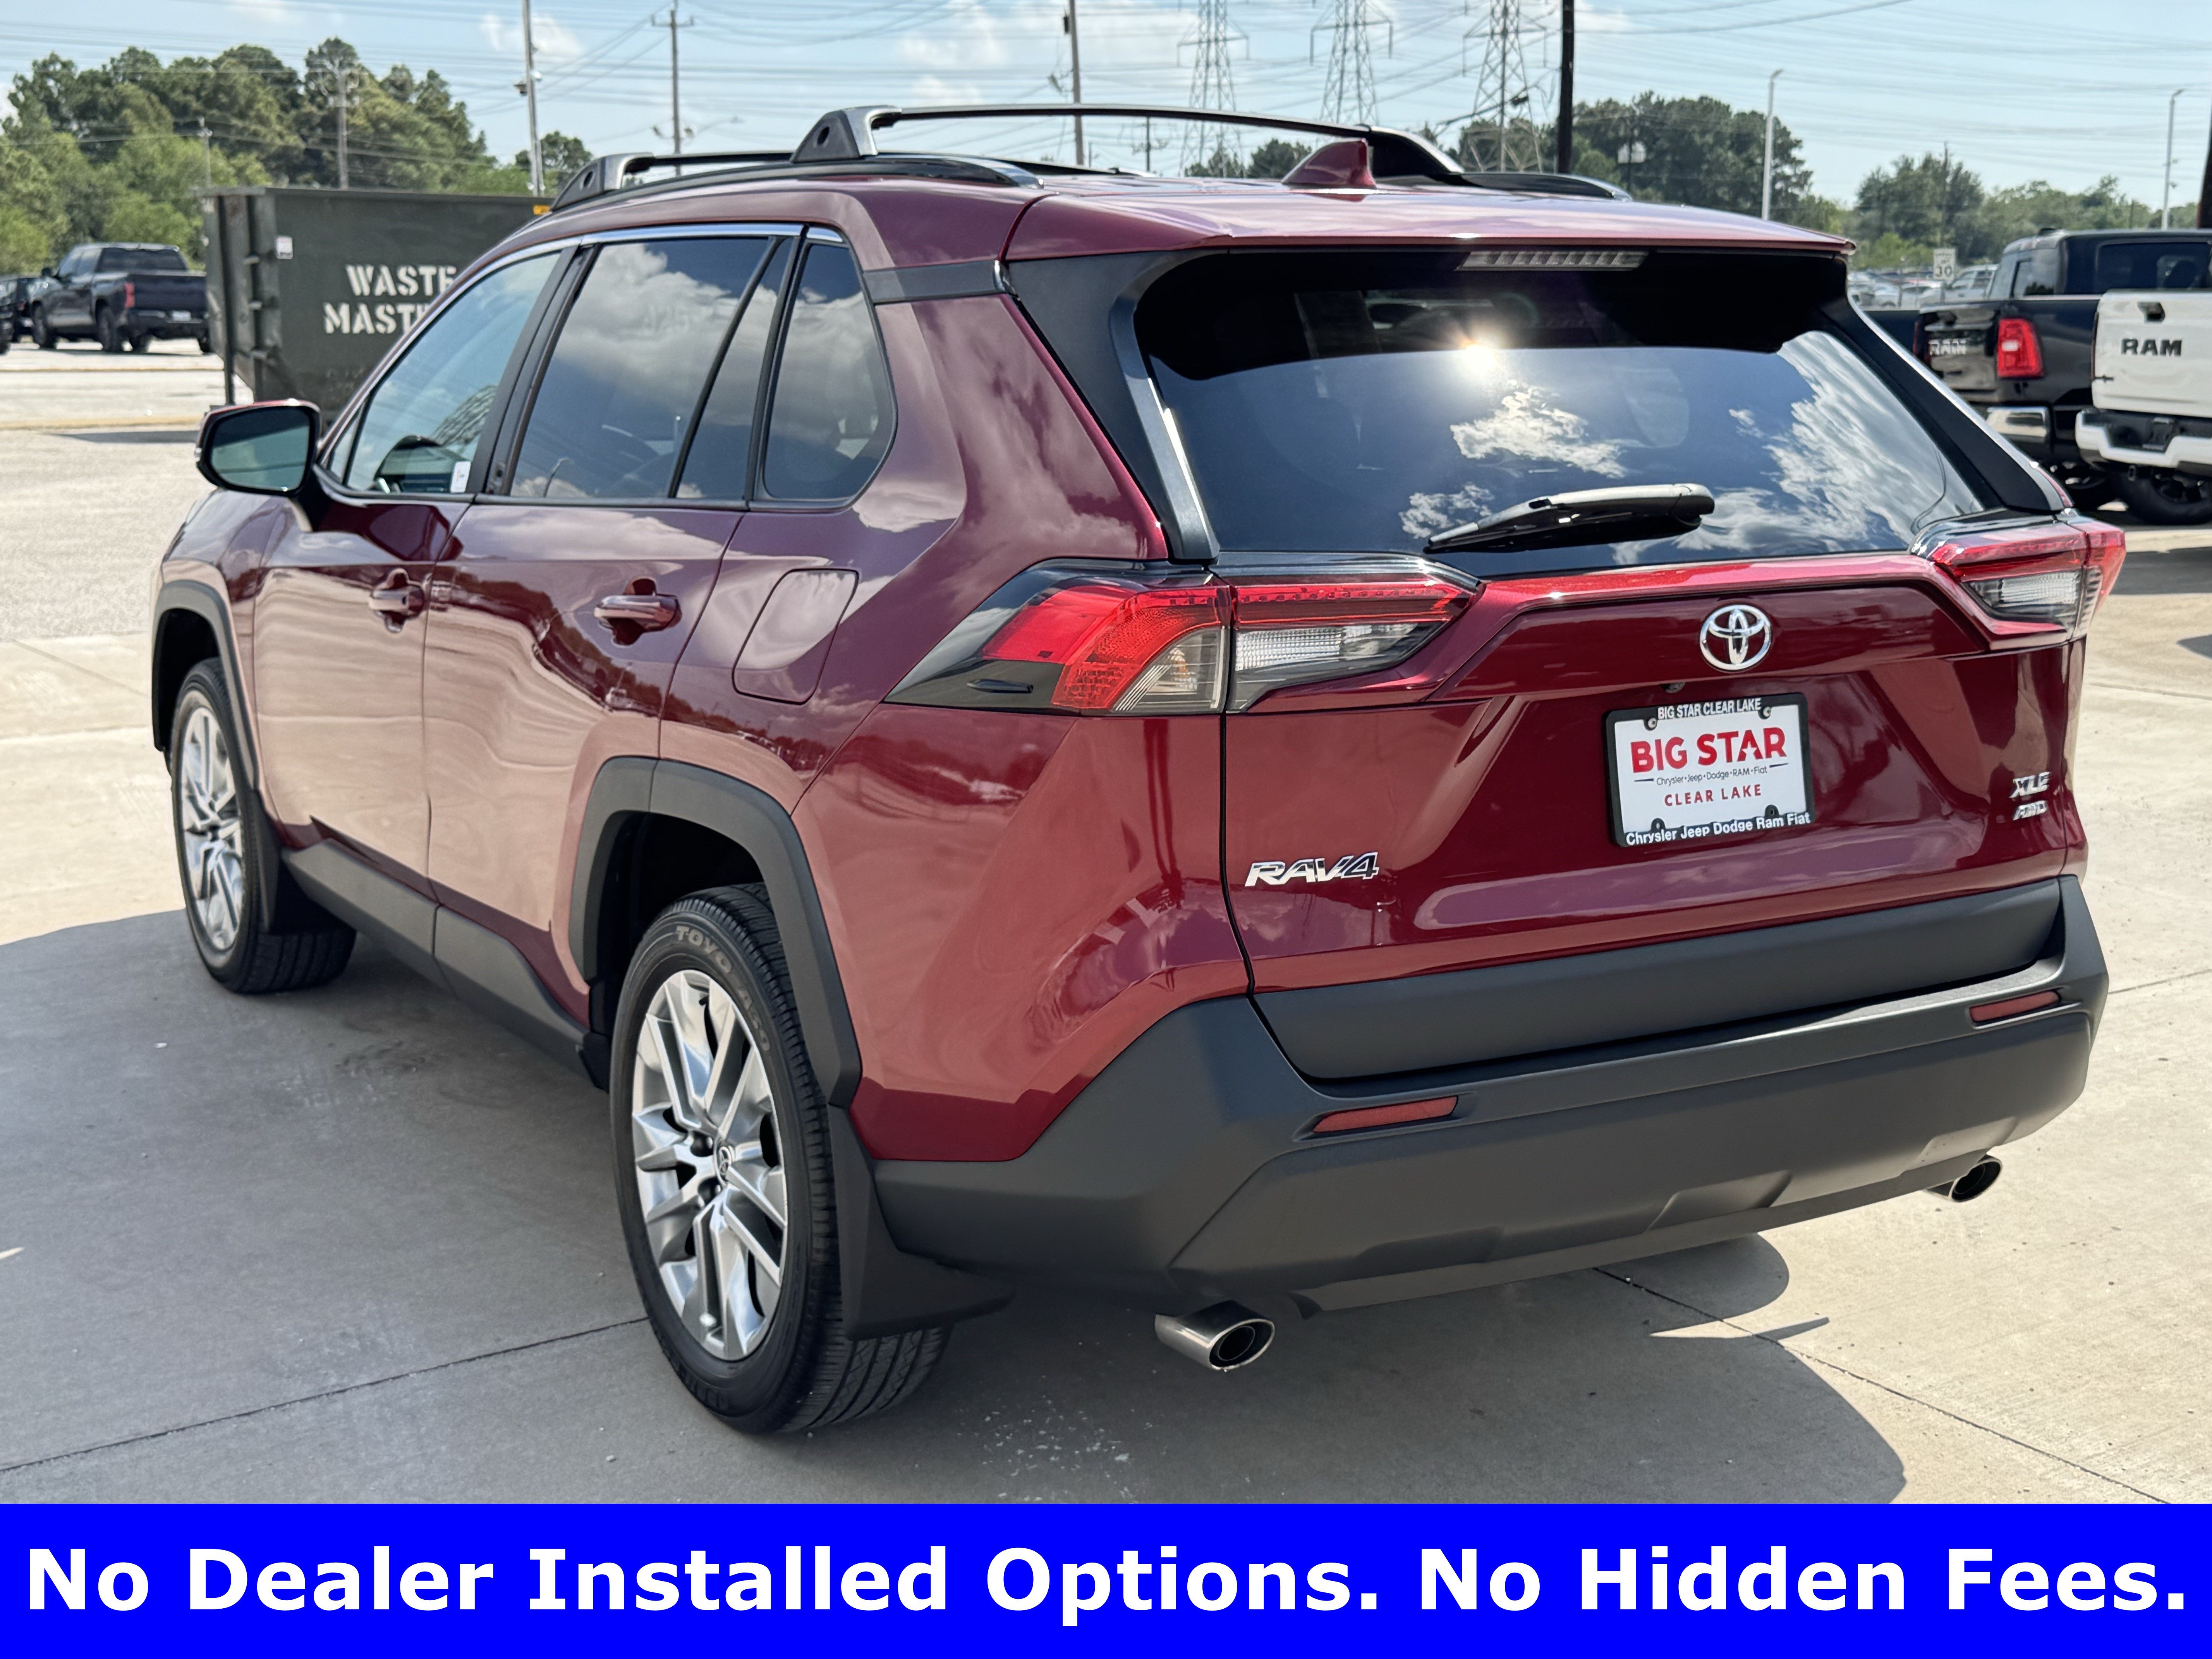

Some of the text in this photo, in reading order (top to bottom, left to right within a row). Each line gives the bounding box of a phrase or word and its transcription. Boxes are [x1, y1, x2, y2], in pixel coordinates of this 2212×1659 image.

[345, 264, 457, 296] WASTE
[323, 302, 430, 334] MAST
[2121, 338, 2182, 357] RAM
[1658, 697, 1762, 720] BIG STAR CLEAR LAKE
[1630, 727, 1787, 773] BIG STAR
[1664, 784, 1761, 806] CLEAR LAKE
[2009, 771, 2051, 798] XLE
[1626, 812, 1811, 845] Chrysler Jeep Dodge Ram Fiat
[1245, 852, 1380, 887] RAV4
[676, 926, 732, 973] TOYO
